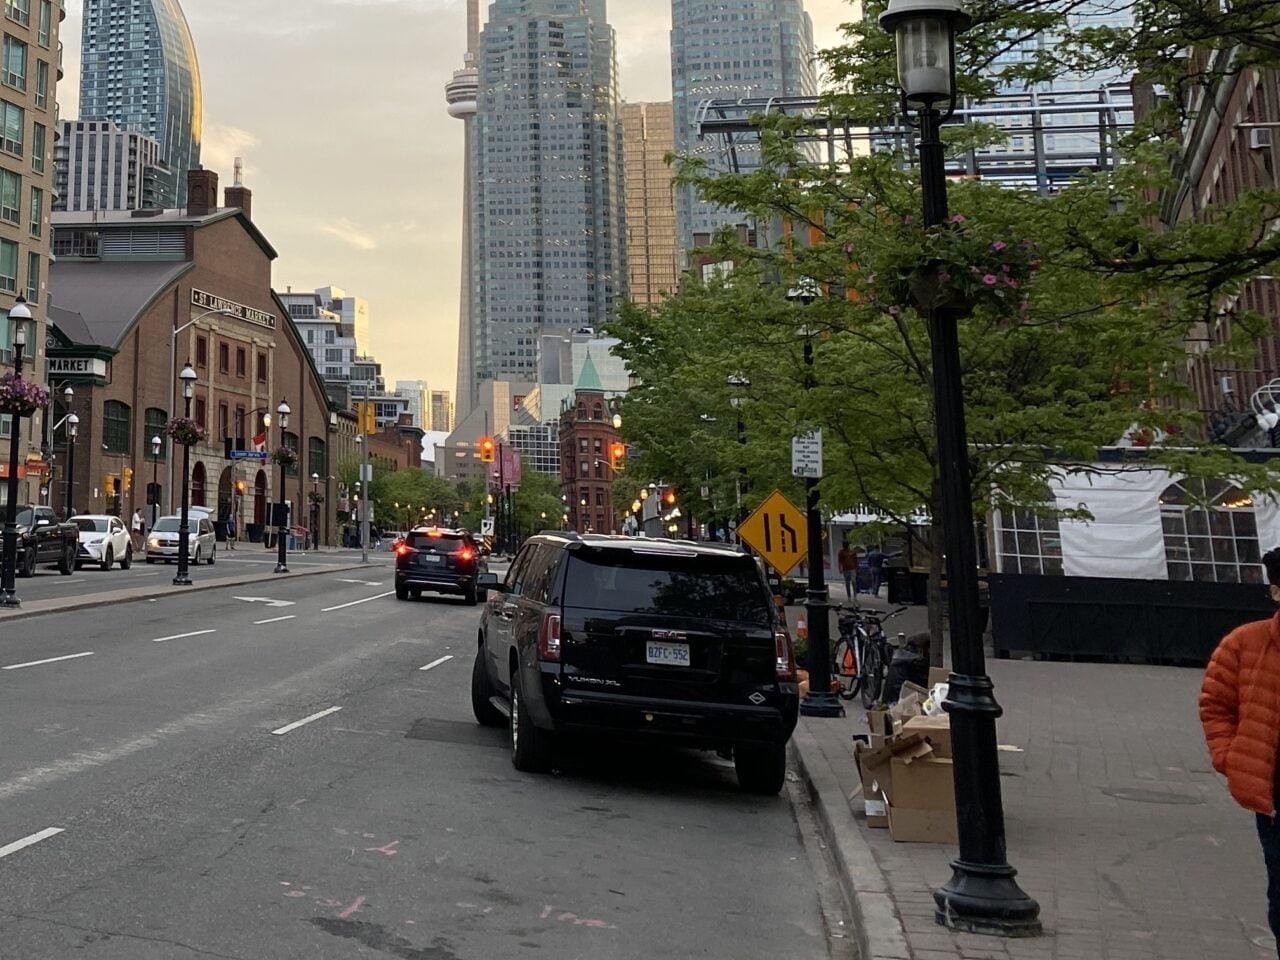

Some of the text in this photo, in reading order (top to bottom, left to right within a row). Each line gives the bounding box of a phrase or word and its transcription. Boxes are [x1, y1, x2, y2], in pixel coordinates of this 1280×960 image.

[245, 308, 271, 326] MARKET
[49, 359, 89, 372] MARKET
[652, 629, 687, 640] GMC
